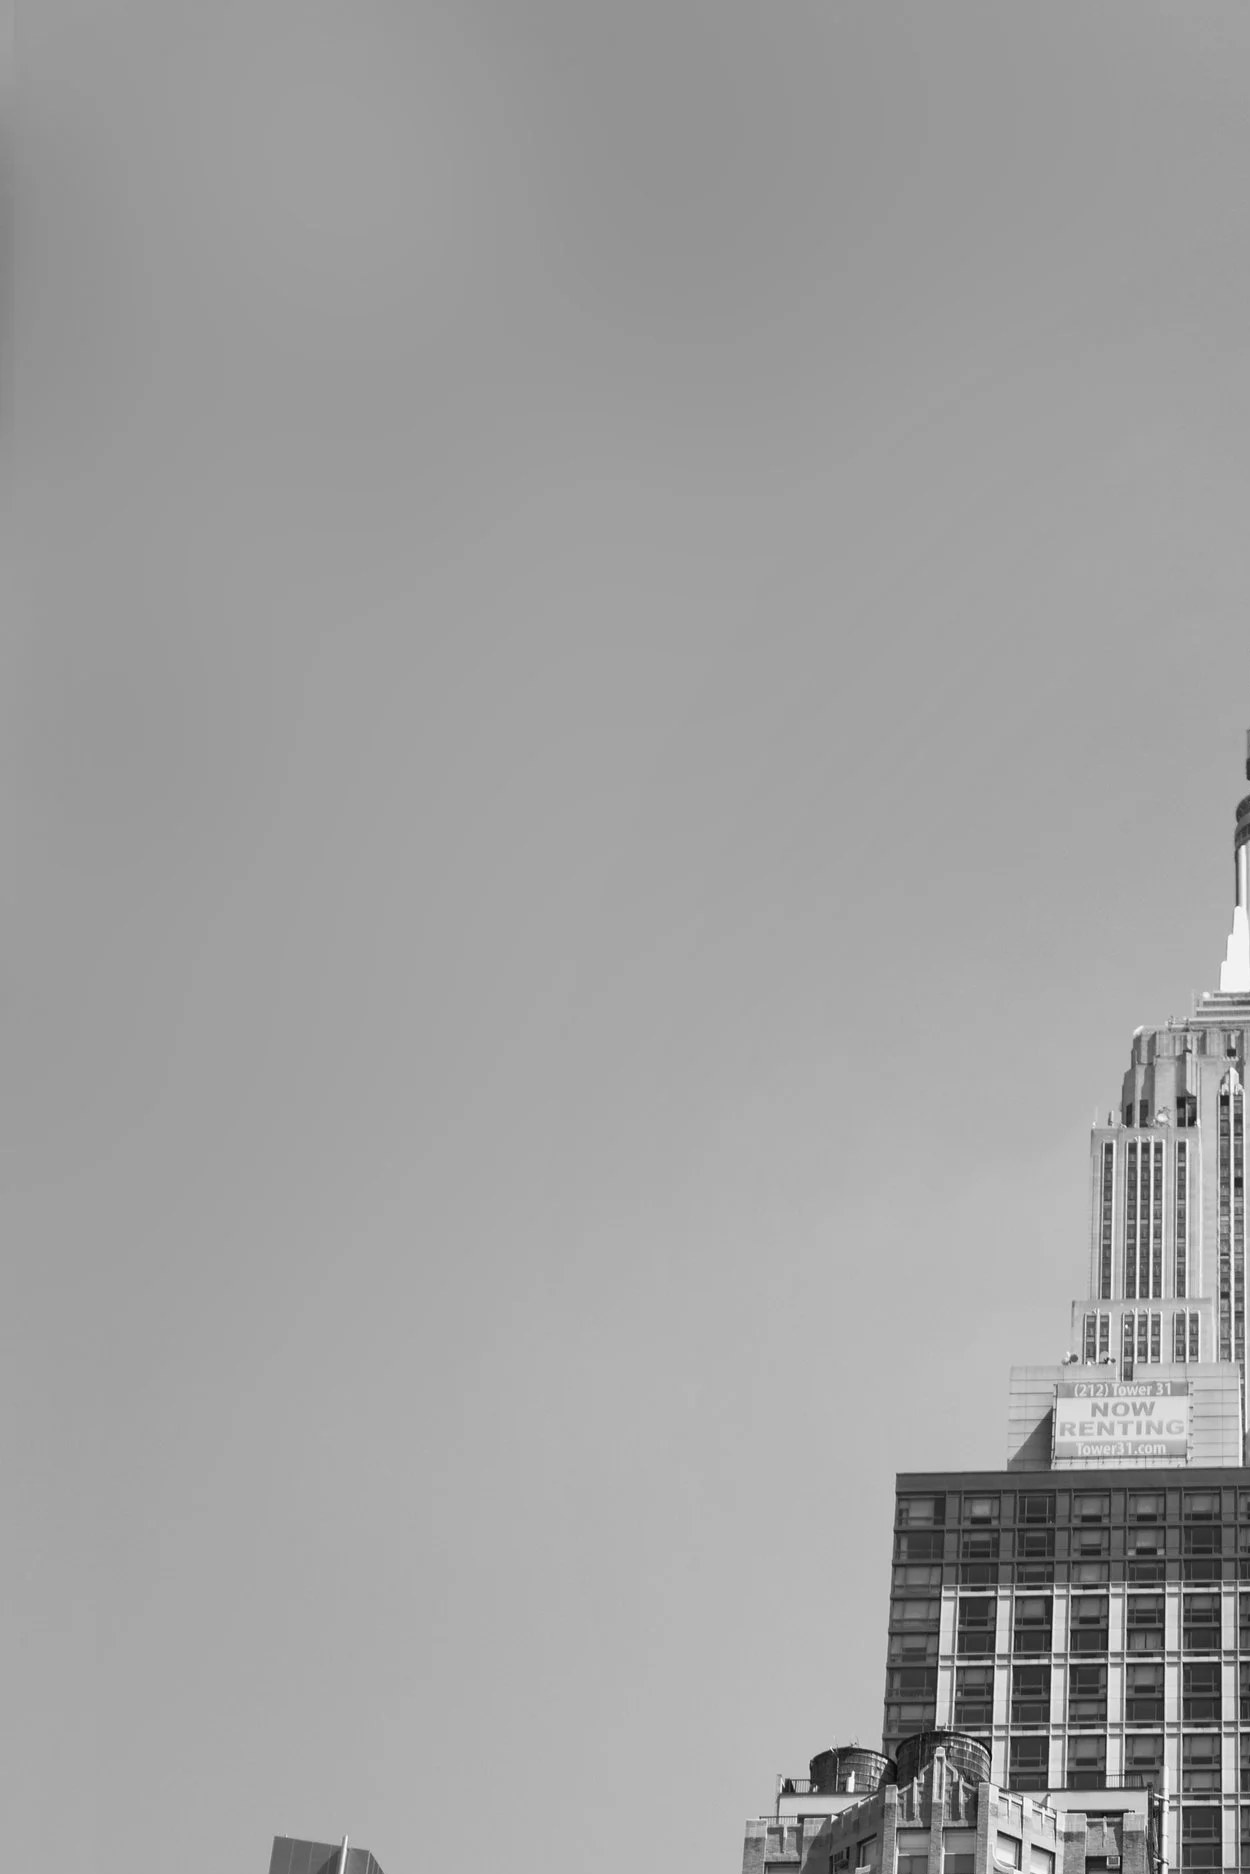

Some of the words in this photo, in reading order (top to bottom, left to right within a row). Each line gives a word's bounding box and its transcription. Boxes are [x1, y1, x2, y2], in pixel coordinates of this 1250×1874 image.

[1074, 1383, 1109, 1397] (212)
[1112, 1383, 1153, 1396] Tower
[1156, 1382, 1172, 1396] 31
[1091, 1401, 1156, 1418] NOW
[1059, 1419, 1185, 1437] RENTING
[1075, 1442, 1167, 1457] Tower31.com
